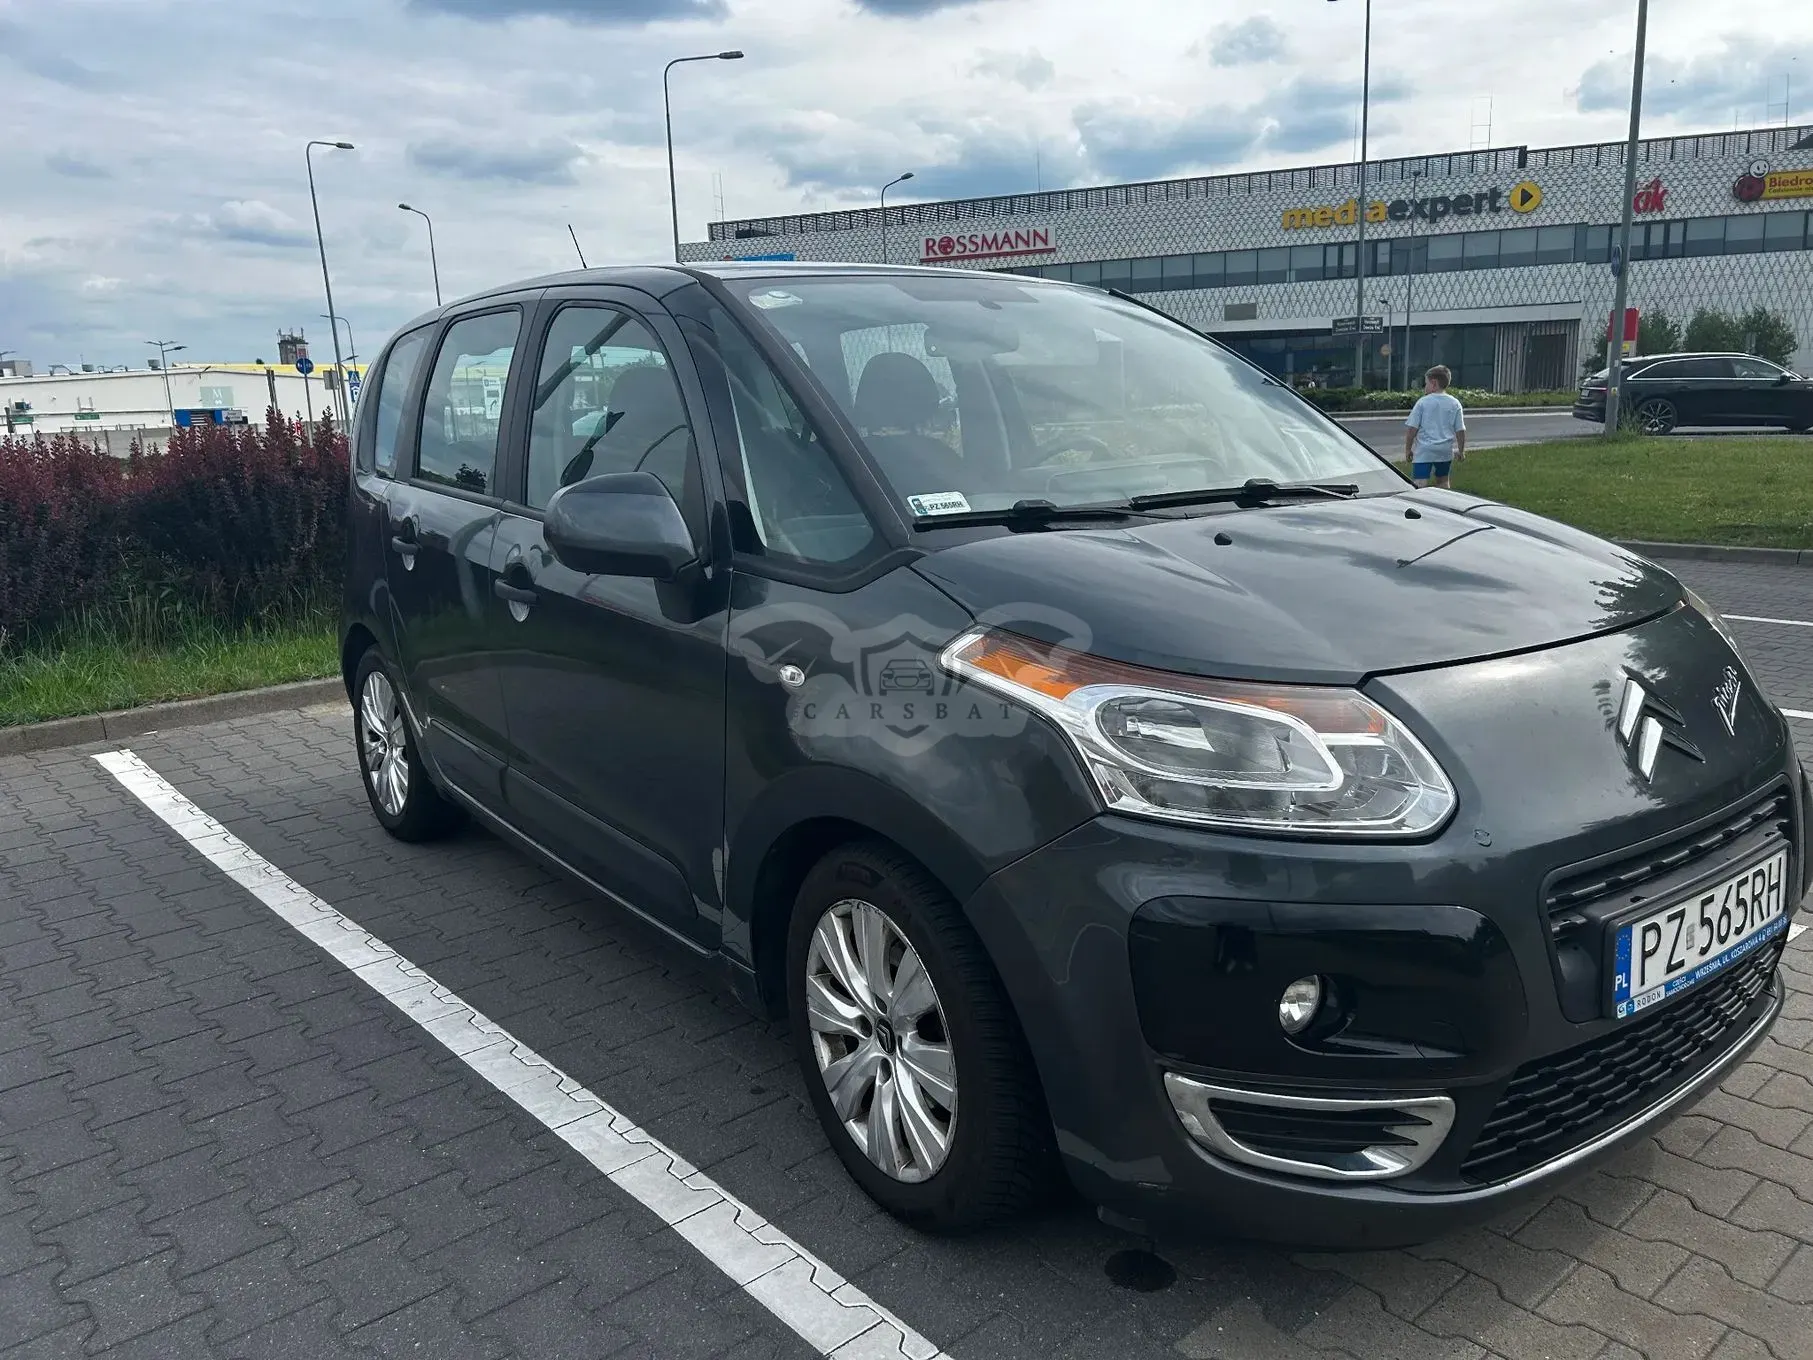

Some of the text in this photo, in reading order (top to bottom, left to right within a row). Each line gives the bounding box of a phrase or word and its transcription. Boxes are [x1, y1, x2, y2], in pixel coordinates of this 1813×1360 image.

[1282, 185, 1501, 230] medaexpert
[925, 228, 1049, 256] ROSSMANN
[1640, 856, 1782, 987] PZ 565RH
[1615, 972, 1628, 992] PL
